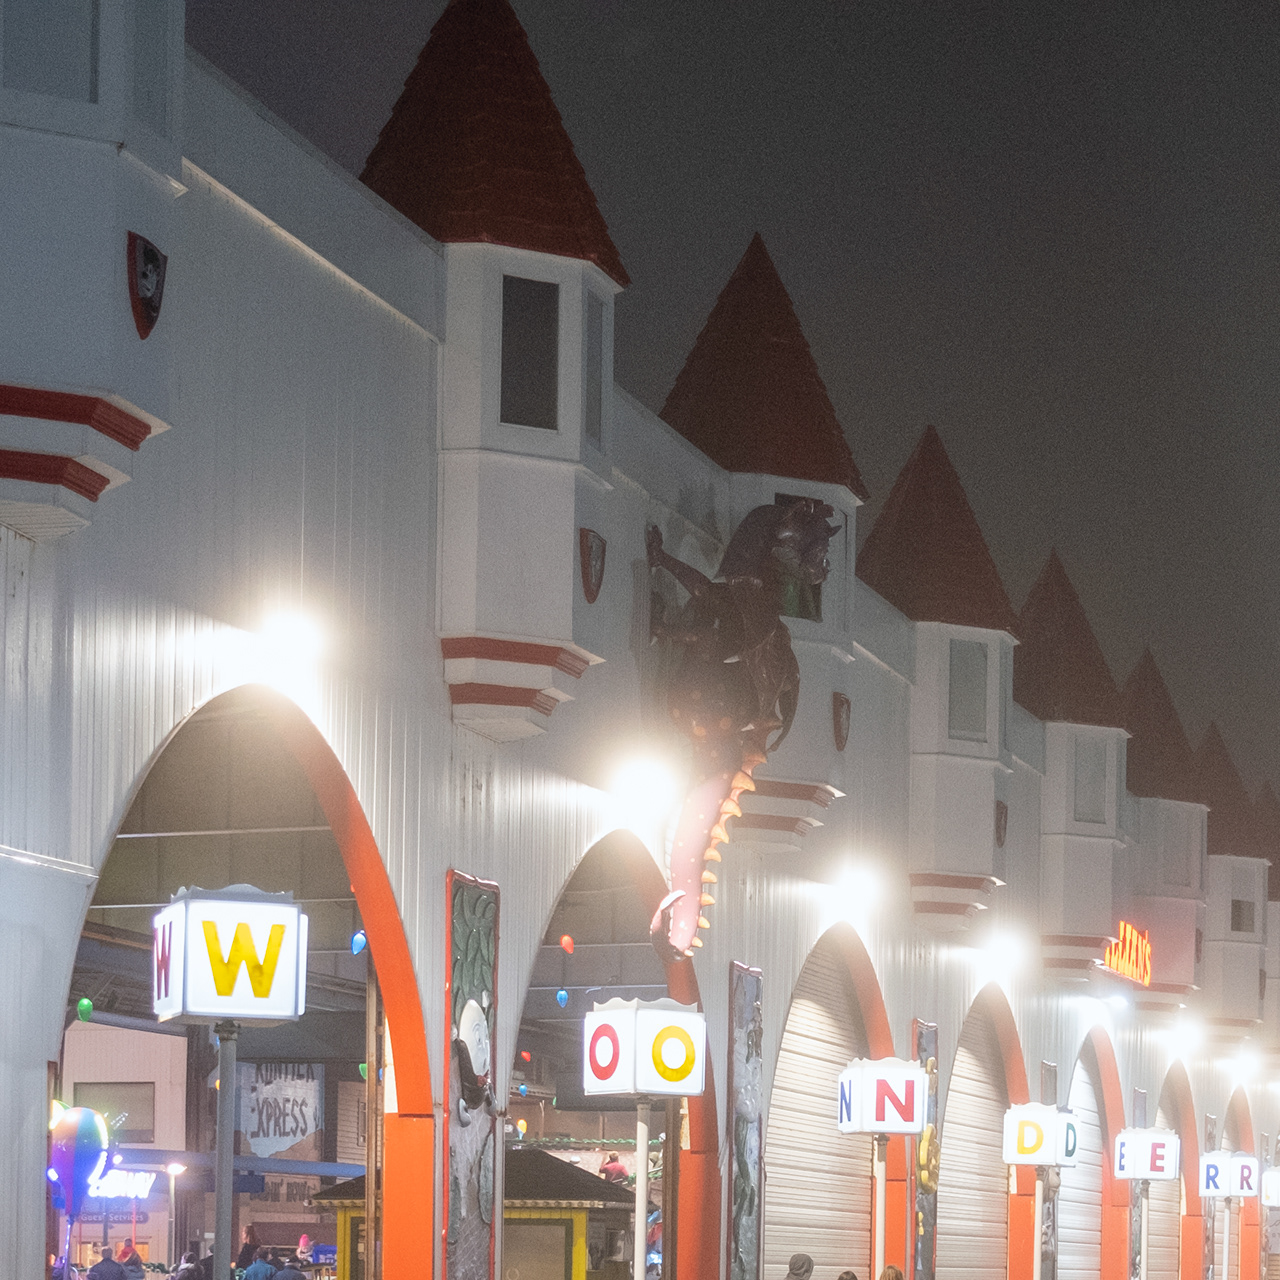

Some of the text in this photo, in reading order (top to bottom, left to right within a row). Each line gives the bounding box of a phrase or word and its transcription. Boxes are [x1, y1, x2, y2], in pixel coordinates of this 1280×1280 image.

[202, 920, 286, 998] W
[589, 1023, 620, 1081] O
[651, 1025, 696, 1082] O
[875, 1079, 915, 1122] N
[1017, 1120, 1044, 1155] D
[1064, 1122, 1077, 1157] D
[1149, 1142, 1166, 1172] E
[1205, 1163, 1220, 1190] R
[1240, 1164, 1253, 1191] R
